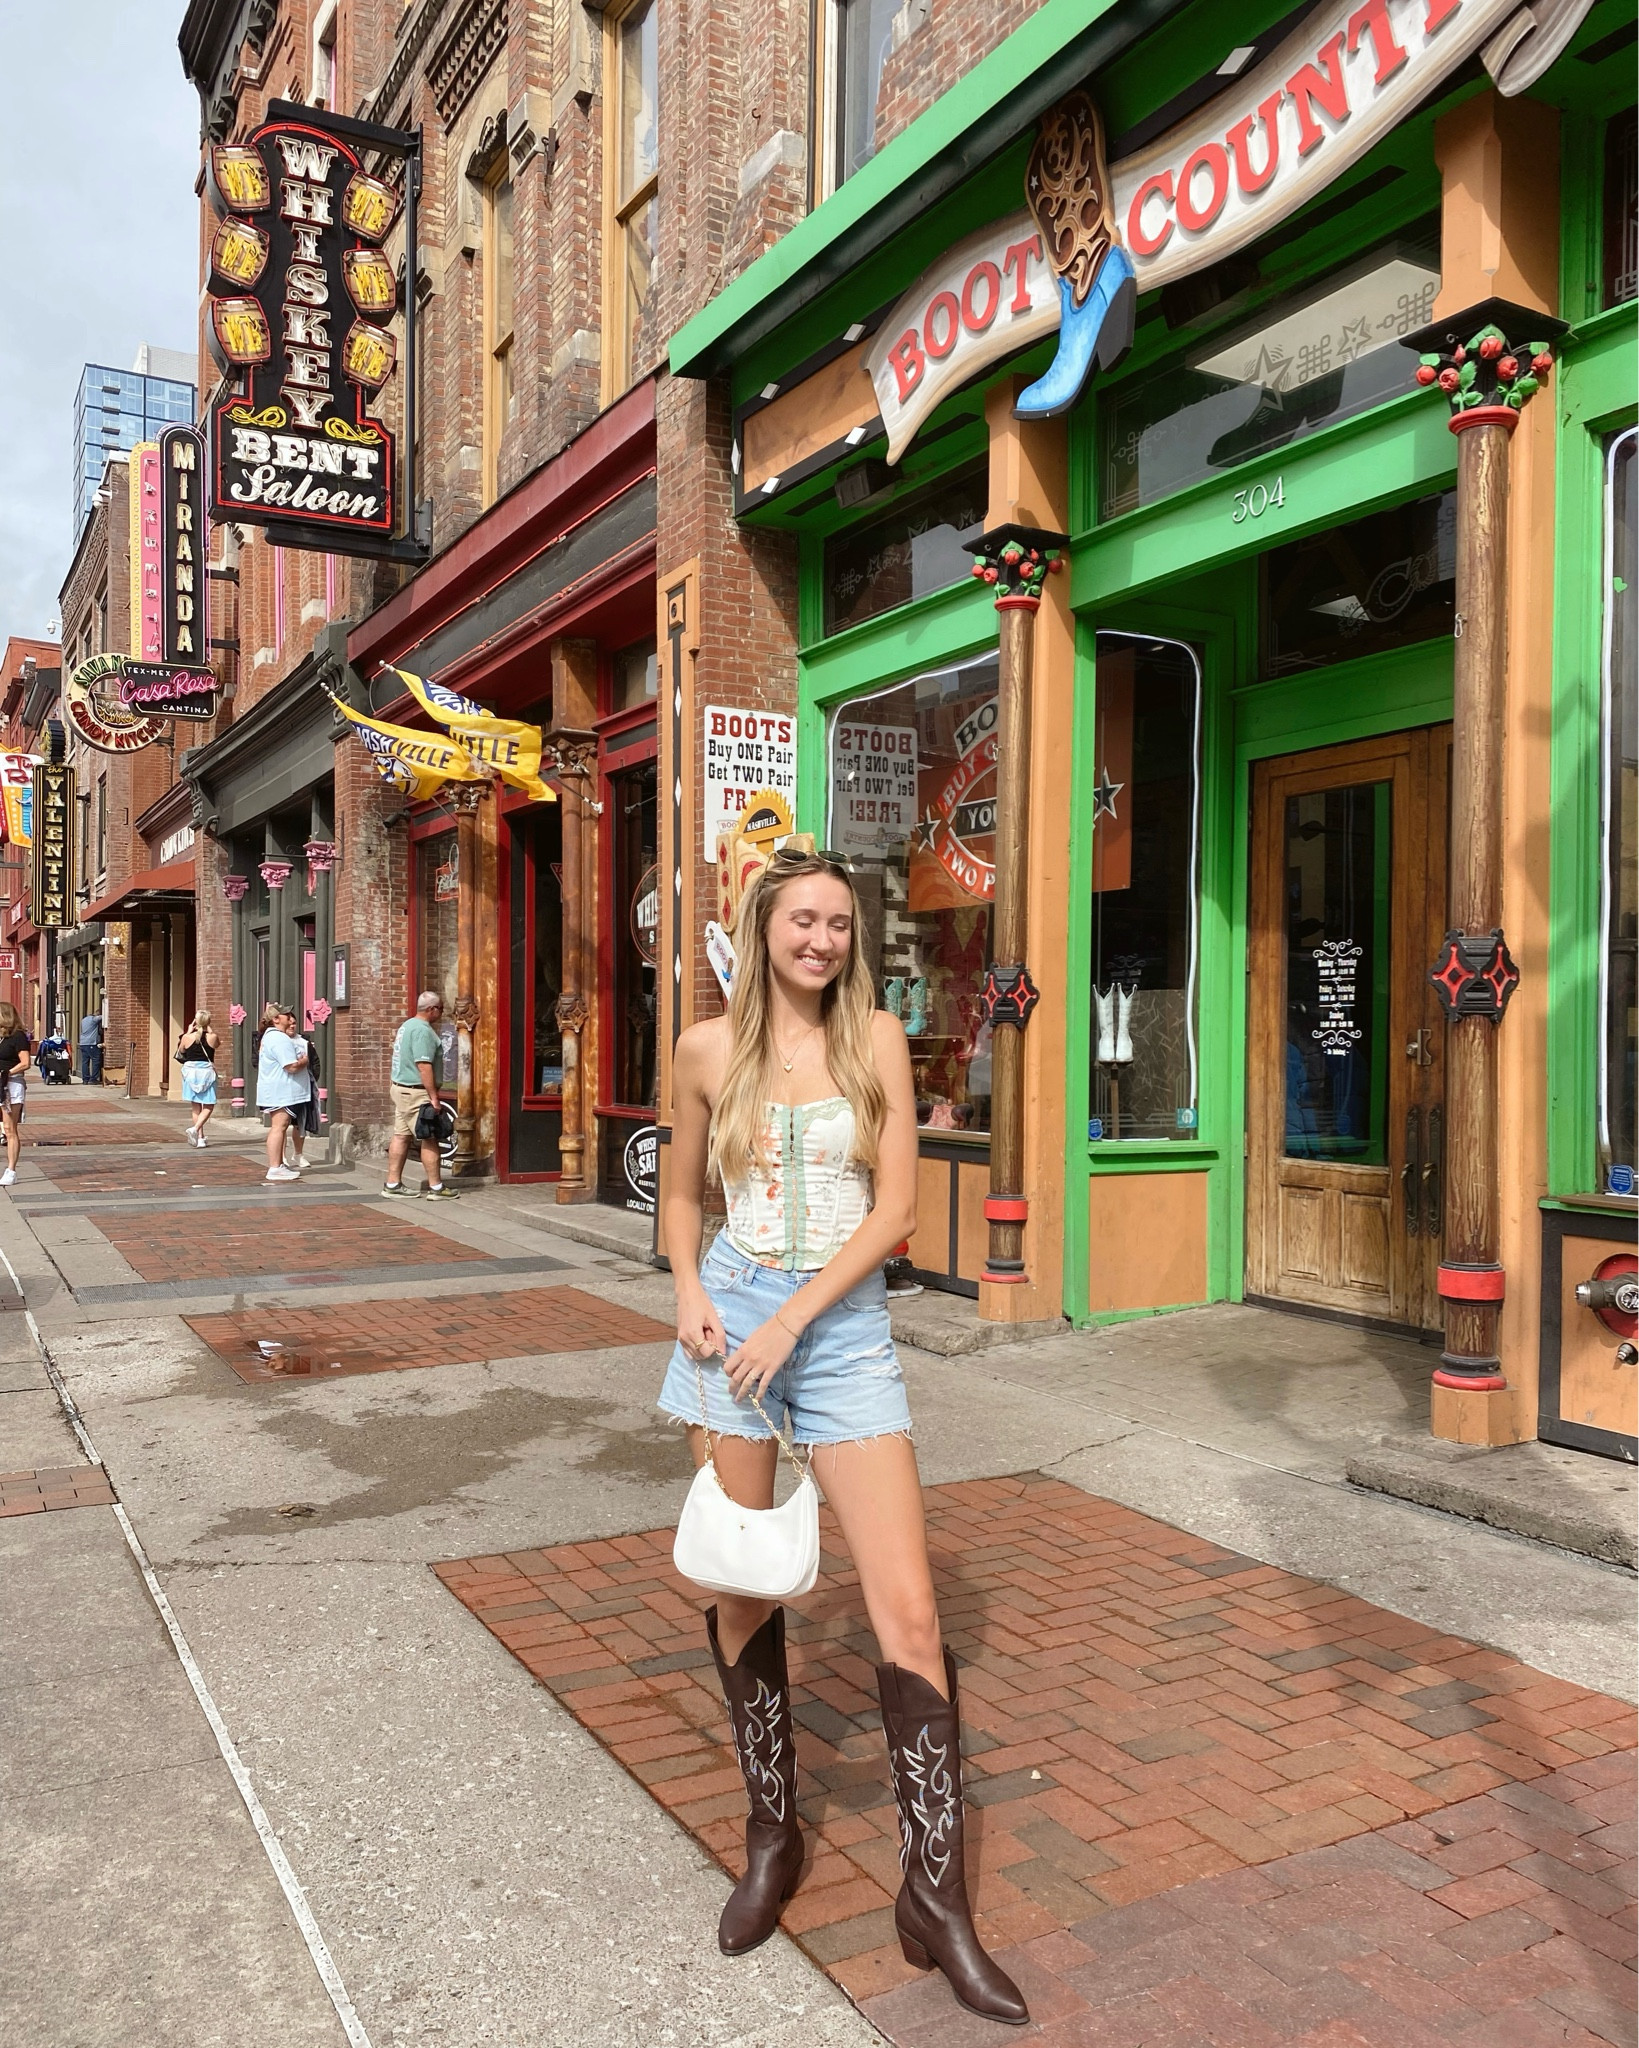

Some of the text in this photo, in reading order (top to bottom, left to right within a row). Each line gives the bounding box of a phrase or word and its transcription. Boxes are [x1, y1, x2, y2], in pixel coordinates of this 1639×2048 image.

[276, 135, 338, 430] WHISKEY
[888, 234, 1043, 404] BOOT
[231, 427, 379, 480] BENT
[230, 464, 380, 518] Saloon
[1232, 476, 1287, 522] 304
[172, 441, 195, 653] MIRANDA
[120, 671, 220, 704] Casa Rosa
[126, 666, 171, 677] TEX-MEX
[70, 701, 111, 744] CANDY
[114, 717, 164, 748] KITCHE
[162, 704, 209, 715] CANTINA
[711, 712, 791, 743] BOOTS
[708, 739, 793, 764] Buy ONE Pair
[708, 762, 793, 787] Get TWO Pair
[724, 787, 758, 811] FR
[942, 753, 977, 808] BUY
[747, 815, 778, 832] NASHVILLE
[44, 775, 65, 925] VALENTINE
[942, 839, 977, 887] TWO
